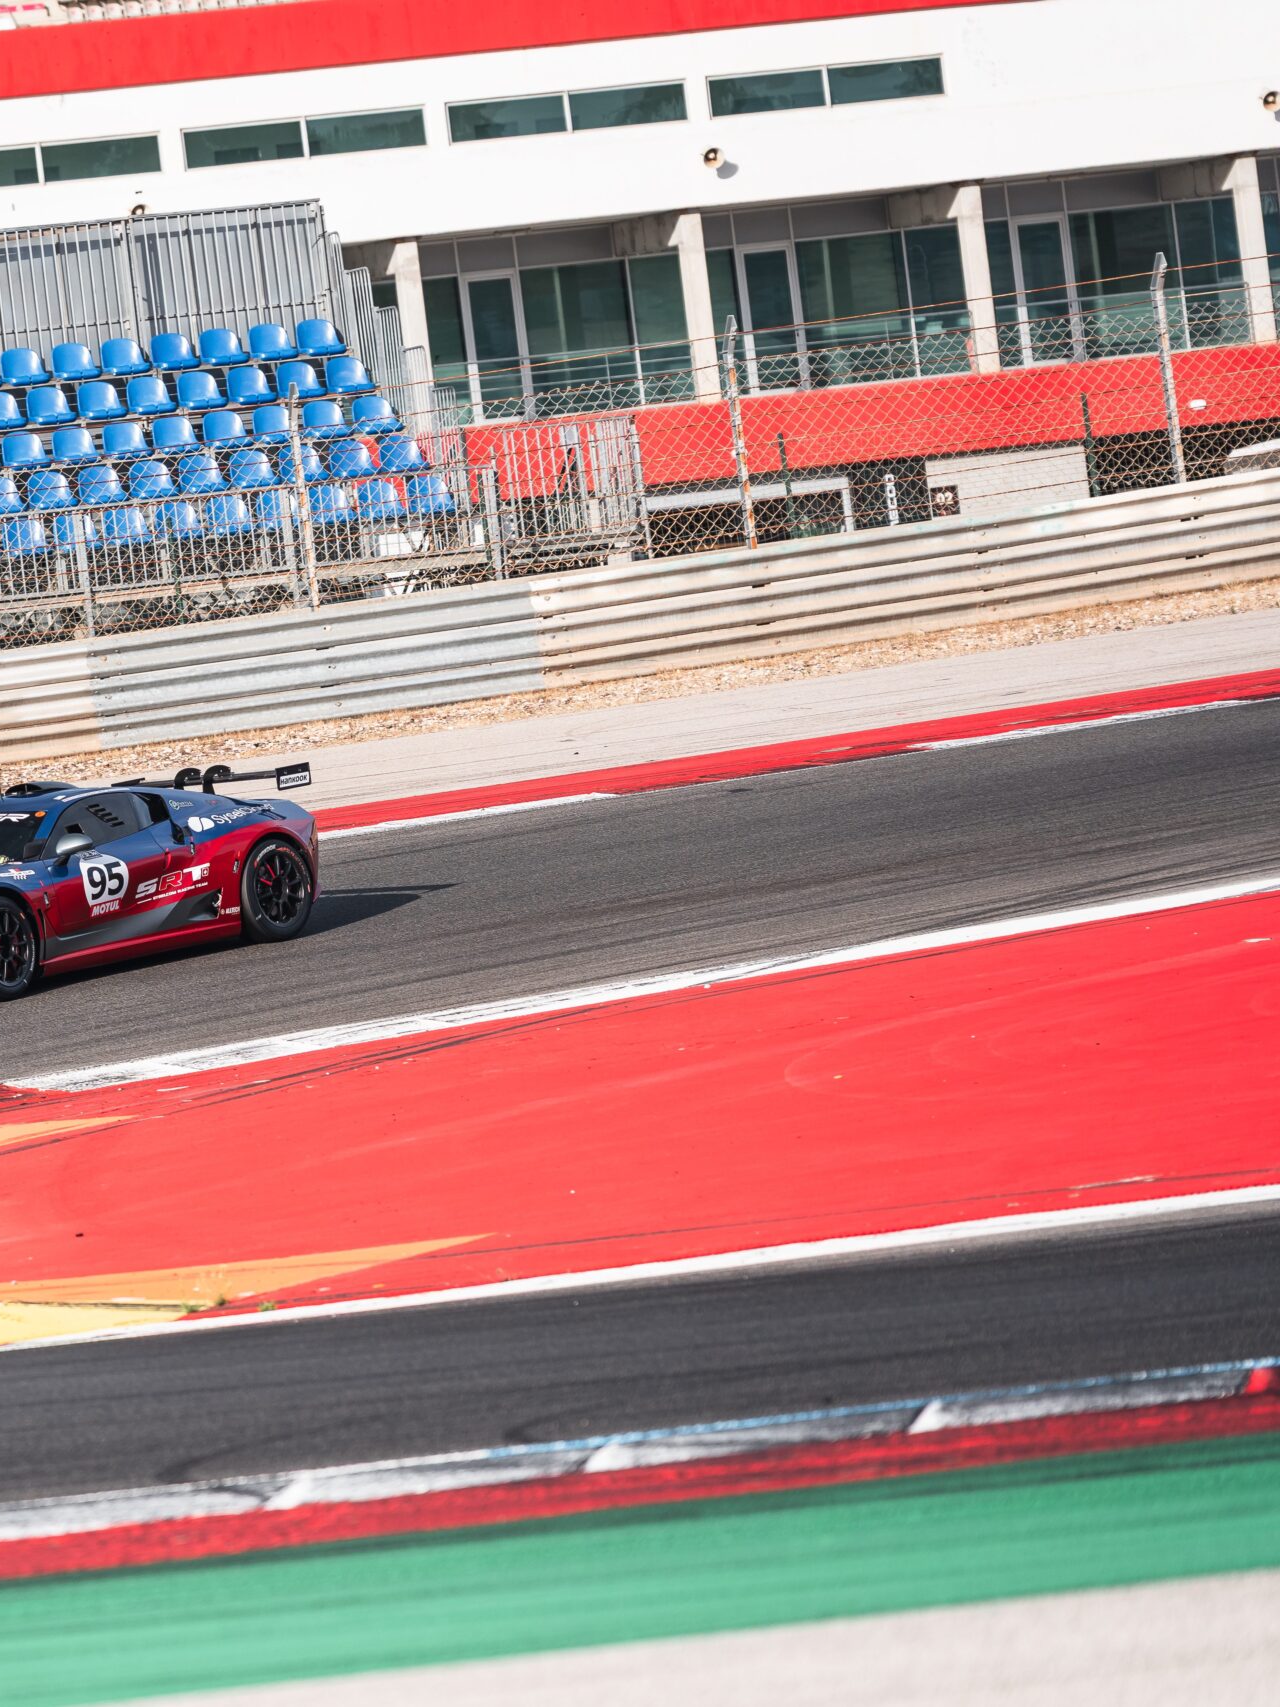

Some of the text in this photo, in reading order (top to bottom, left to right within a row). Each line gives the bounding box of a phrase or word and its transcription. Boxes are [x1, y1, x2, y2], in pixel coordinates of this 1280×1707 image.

[936, 491, 955, 505] 02
[86, 861, 124, 900] 95
[135, 862, 210, 899] SRT
[91, 900, 120, 917] MOTUL
